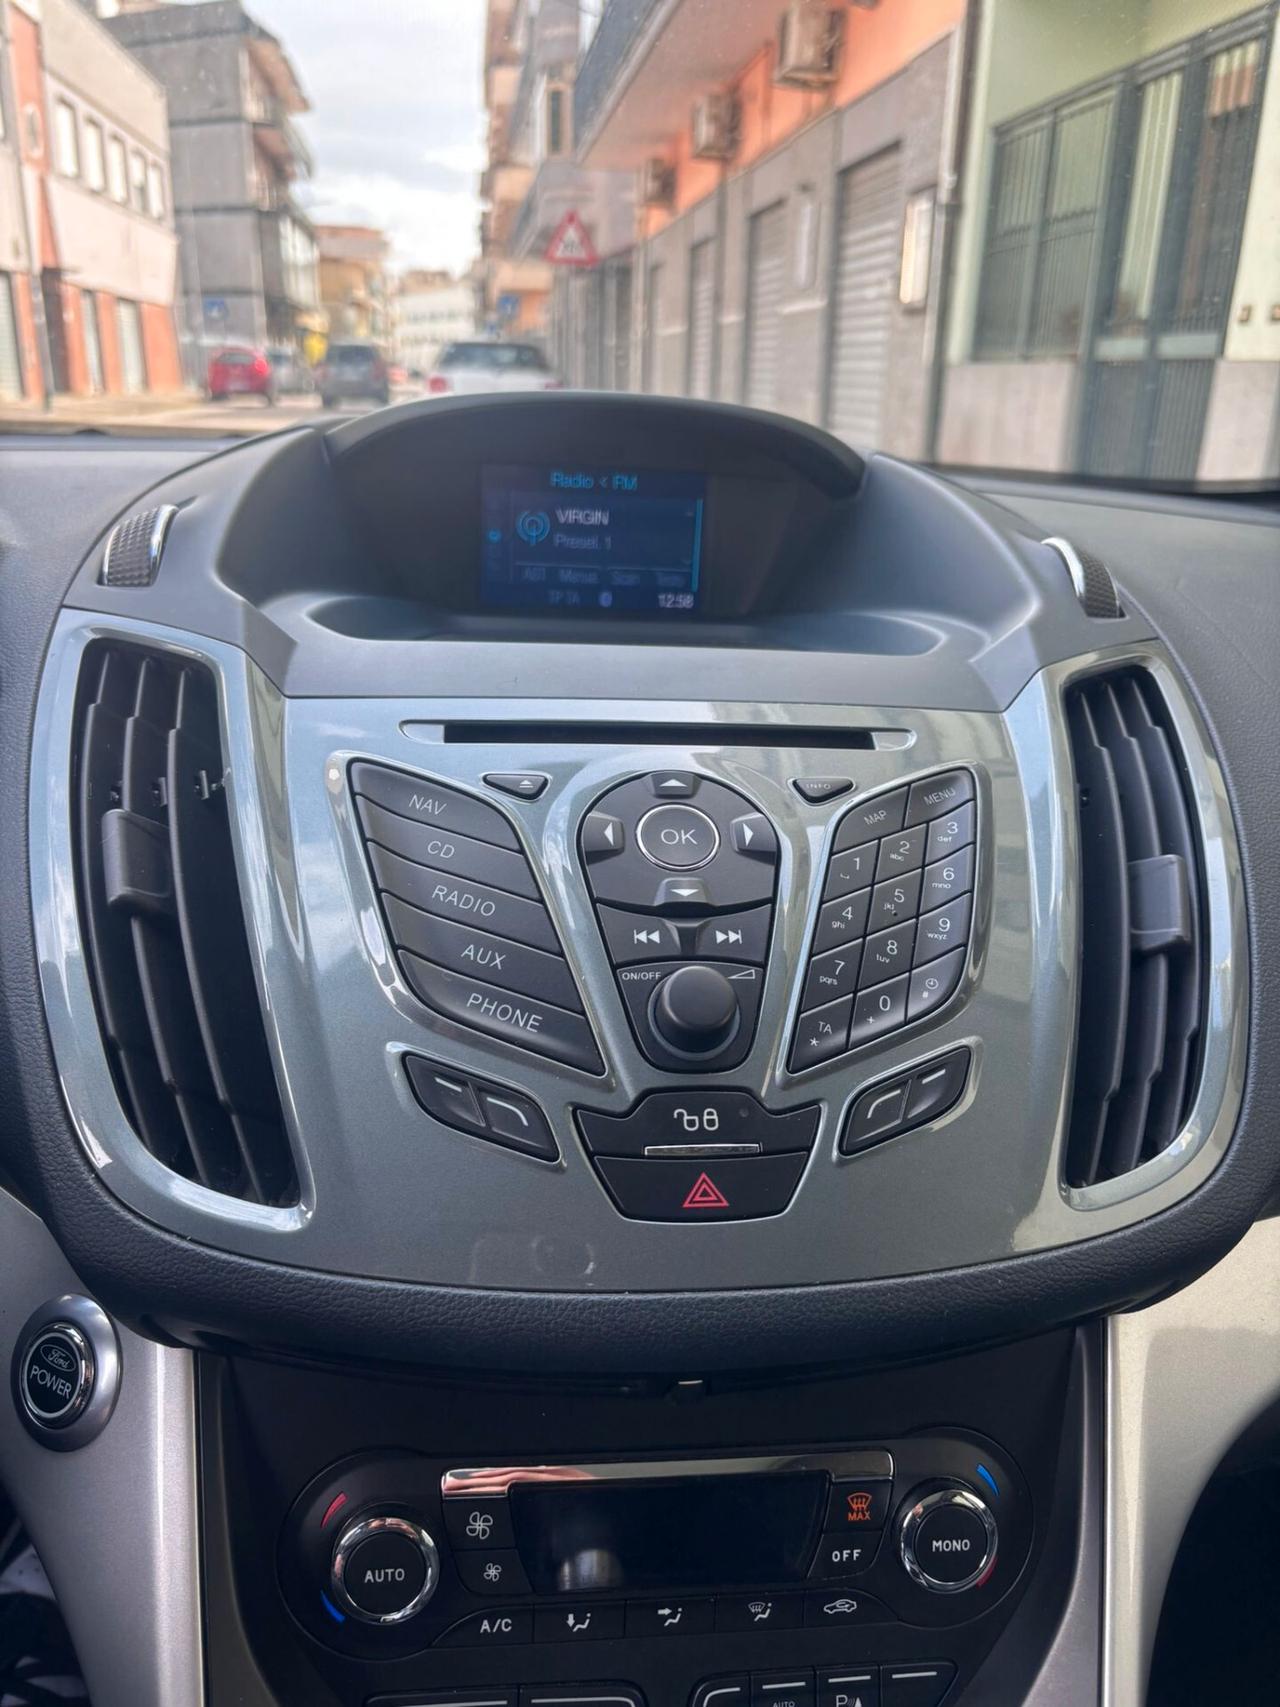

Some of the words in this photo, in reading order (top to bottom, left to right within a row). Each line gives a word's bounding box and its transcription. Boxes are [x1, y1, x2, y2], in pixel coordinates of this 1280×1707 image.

[550, 472, 593, 488] Radio
[612, 474, 638, 490] FM
[556, 509, 610, 526] VIRGIN
[923, 787, 956, 806] MENU
[408, 794, 447, 816] NAV
[864, 810, 887, 826] MAP
[947, 821, 958, 834] 3
[660, 828, 698, 845] OK
[427, 840, 455, 859] CD
[899, 841, 910, 854] 2
[853, 857, 861, 870] 1
[943, 867, 955, 881] 6
[431, 884, 496, 917] RADIO
[894, 888, 905, 903] 5
[842, 906, 853, 921] 4
[831, 919, 845, 930] ghi
[938, 918, 951, 932] 9
[887, 940, 898, 955] 8
[461, 944, 506, 970] AUX
[876, 953, 891, 964] tuv
[621, 971, 661, 981] ON/OFF
[833, 960, 846, 976] 7
[879, 995, 891, 1011] 0
[467, 993, 543, 1033] PHONE
[818, 1021, 833, 1035] TA
[48, 1349, 70, 1369] Ford
[30, 1365, 72, 1399] POWER
[847, 1512, 871, 1521] MAX
[932, 1539, 971, 1552] MONO
[832, 1549, 861, 1562] OFF
[364, 1568, 405, 1584] AUTO
[480, 1618, 512, 1634] A/C
